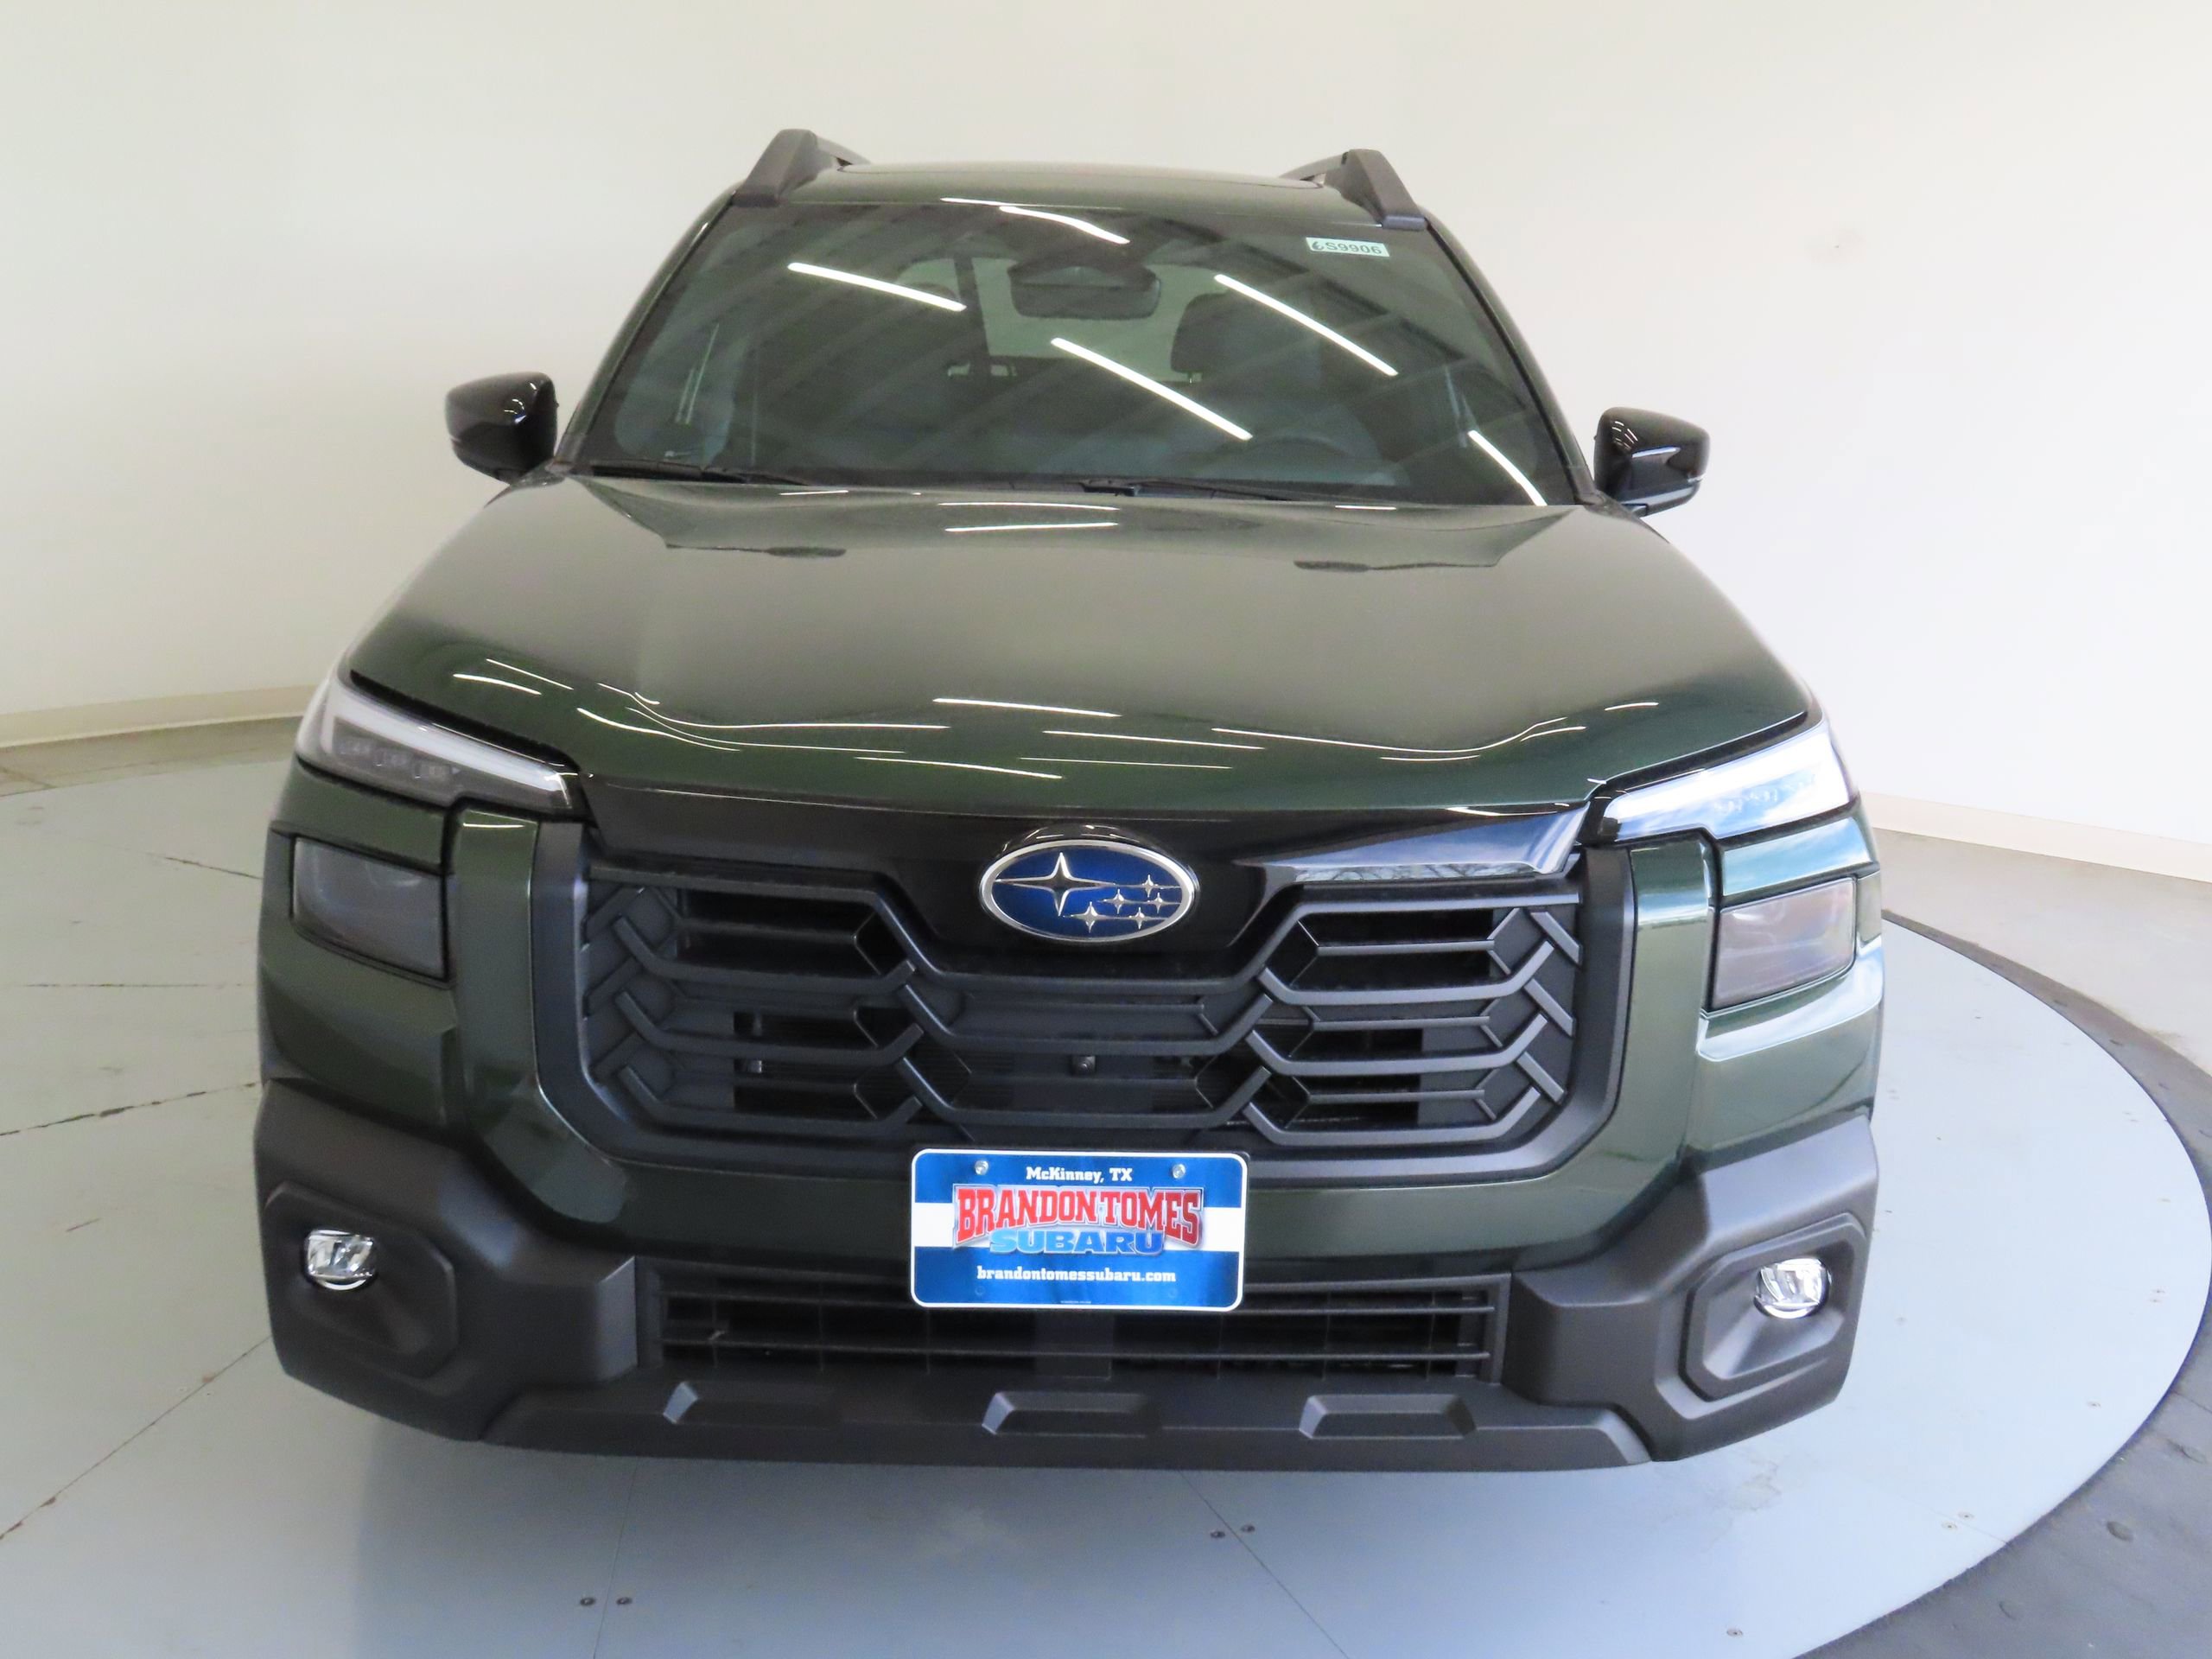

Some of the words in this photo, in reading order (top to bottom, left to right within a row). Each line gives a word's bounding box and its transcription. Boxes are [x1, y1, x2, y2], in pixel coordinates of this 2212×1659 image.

[1026, 1166, 1103, 1184] McKinney,
[1109, 1168, 1133, 1182] TX
[957, 1187, 1097, 1243] BRANDON
[1100, 1192, 1201, 1247] TOMES
[990, 1230, 1165, 1255] SUBARU
[976, 1265, 1176, 1282] brandontomessubaru.com
